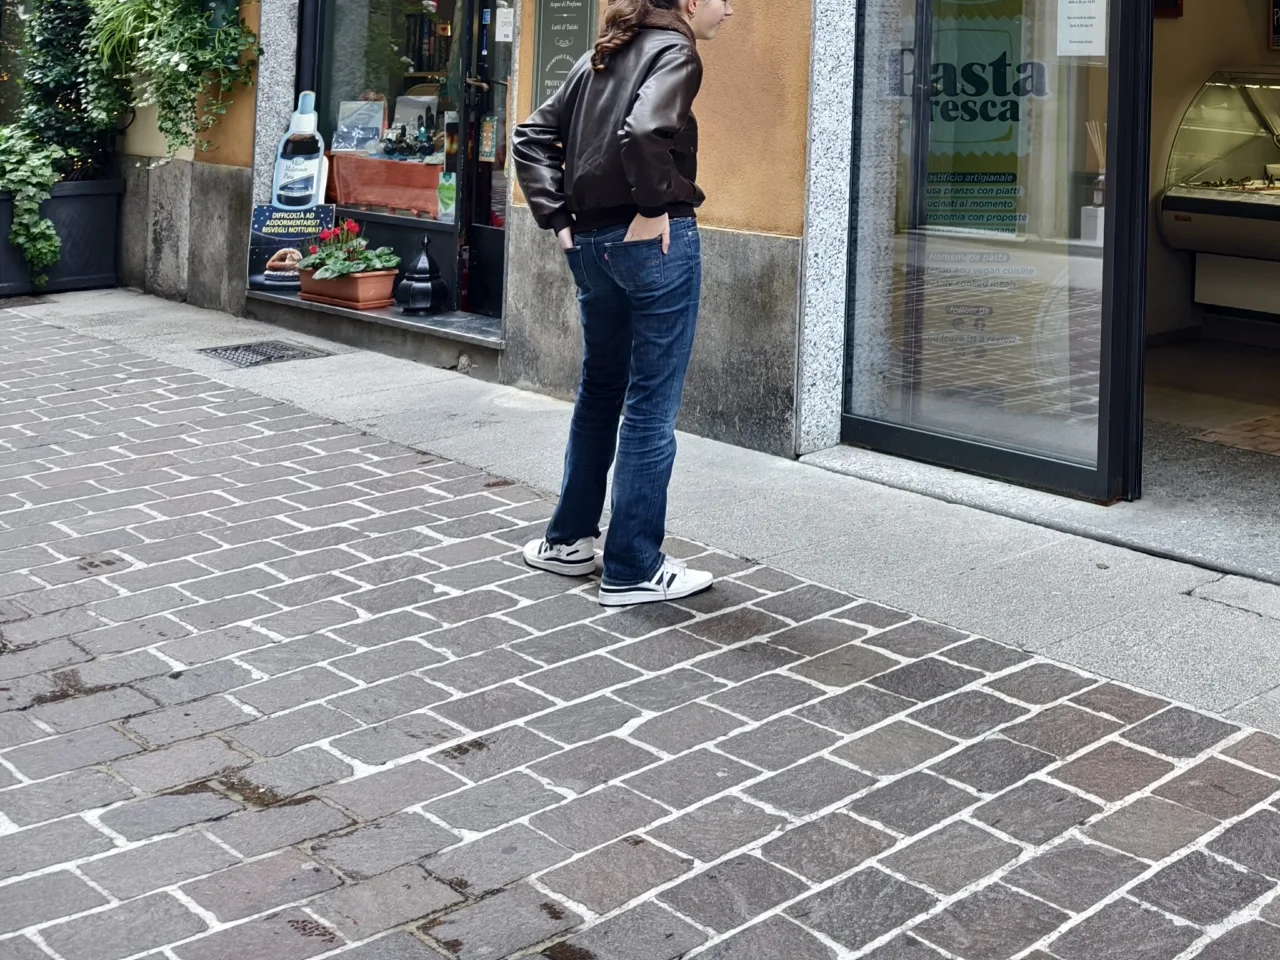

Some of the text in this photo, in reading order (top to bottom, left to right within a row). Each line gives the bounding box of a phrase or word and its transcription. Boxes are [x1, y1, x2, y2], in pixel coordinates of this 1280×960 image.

[930, 99, 1021, 122] resca
[927, 173, 1013, 183] astificio artigianale
[944, 187, 975, 195] pranzo
[996, 186, 1021, 196] piatti
[927, 199, 1013, 208] ucinati al momento
[272, 210, 305, 219] DIFFICOLTÀ
[925, 212, 965, 221] tronomia
[986, 213, 1027, 224] proposte
[288, 226, 322, 234] NOTTURNI?
[982, 253, 1008, 263] pasta
[973, 267, 1001, 276] vegan
[1002, 266, 1035, 275] cuisine
[990, 279, 1017, 288] meals
